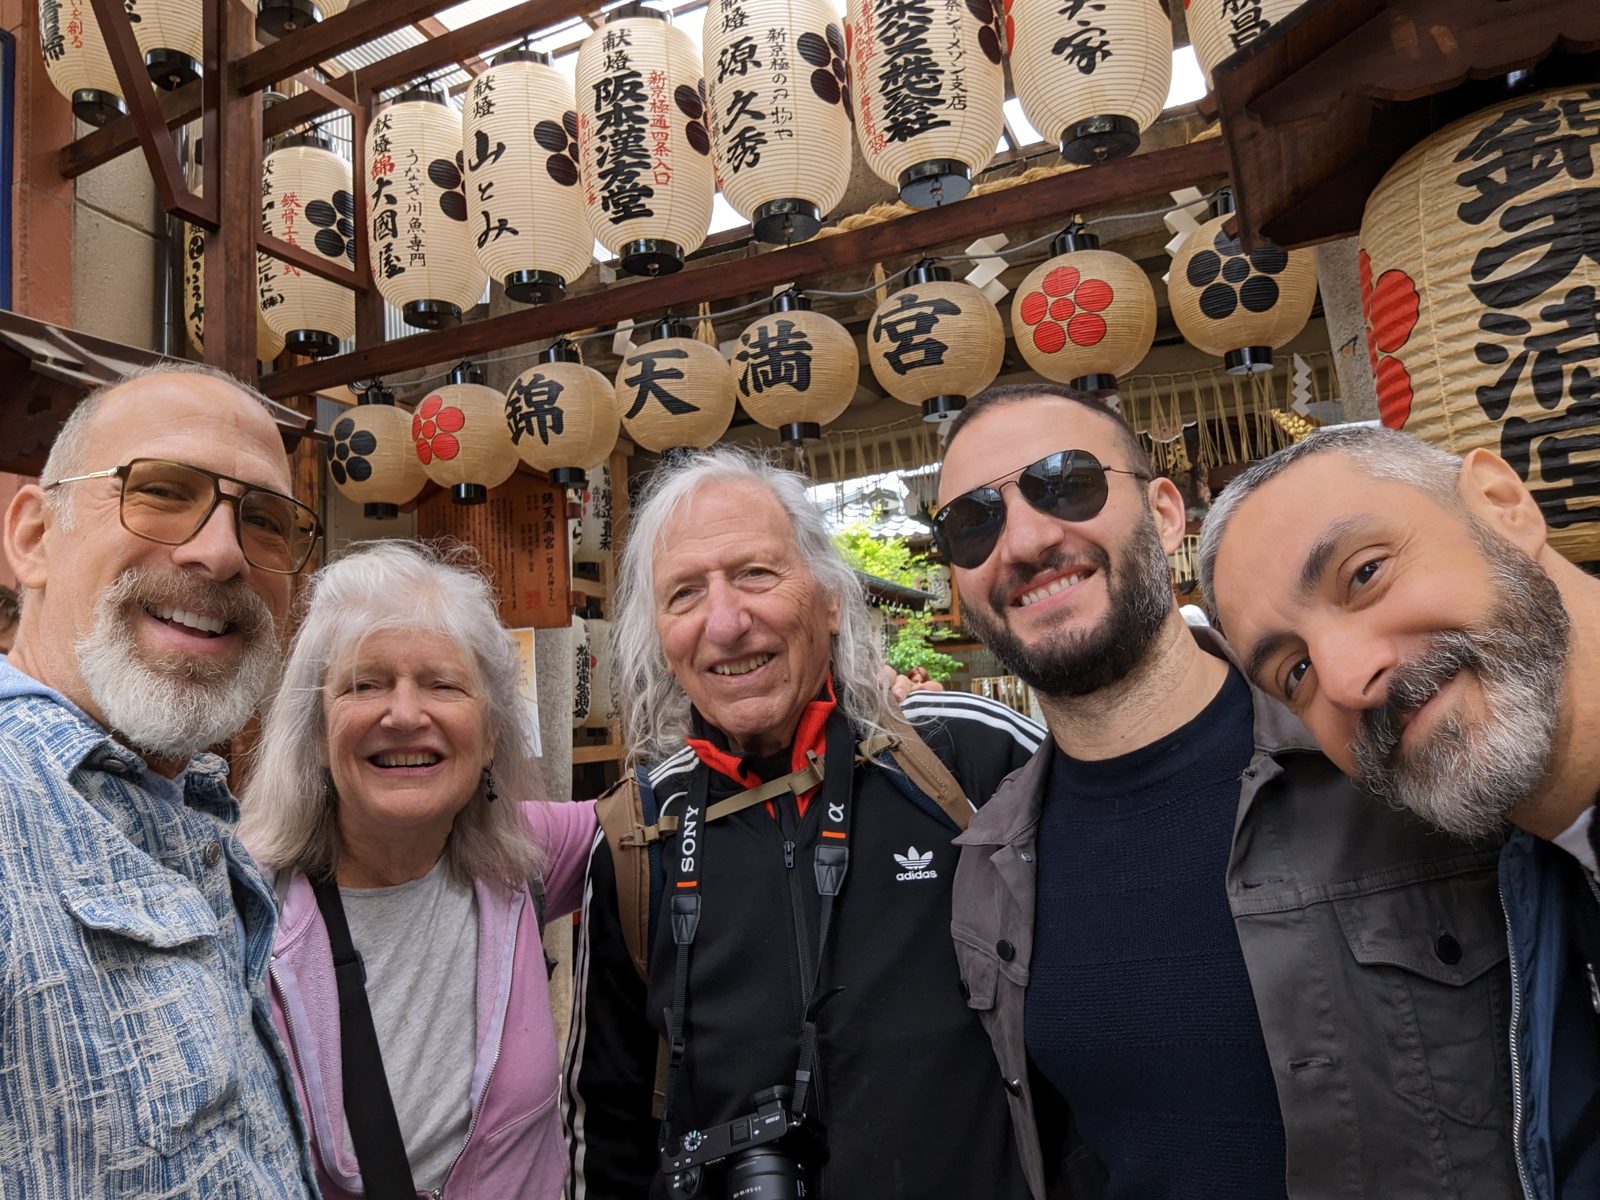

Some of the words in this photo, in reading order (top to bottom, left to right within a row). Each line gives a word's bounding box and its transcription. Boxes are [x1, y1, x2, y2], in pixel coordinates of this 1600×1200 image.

[405, 149, 426, 267] うなぎ川魚専門
[681, 804, 699, 873] SONY
[896, 870, 938, 881] adidas
